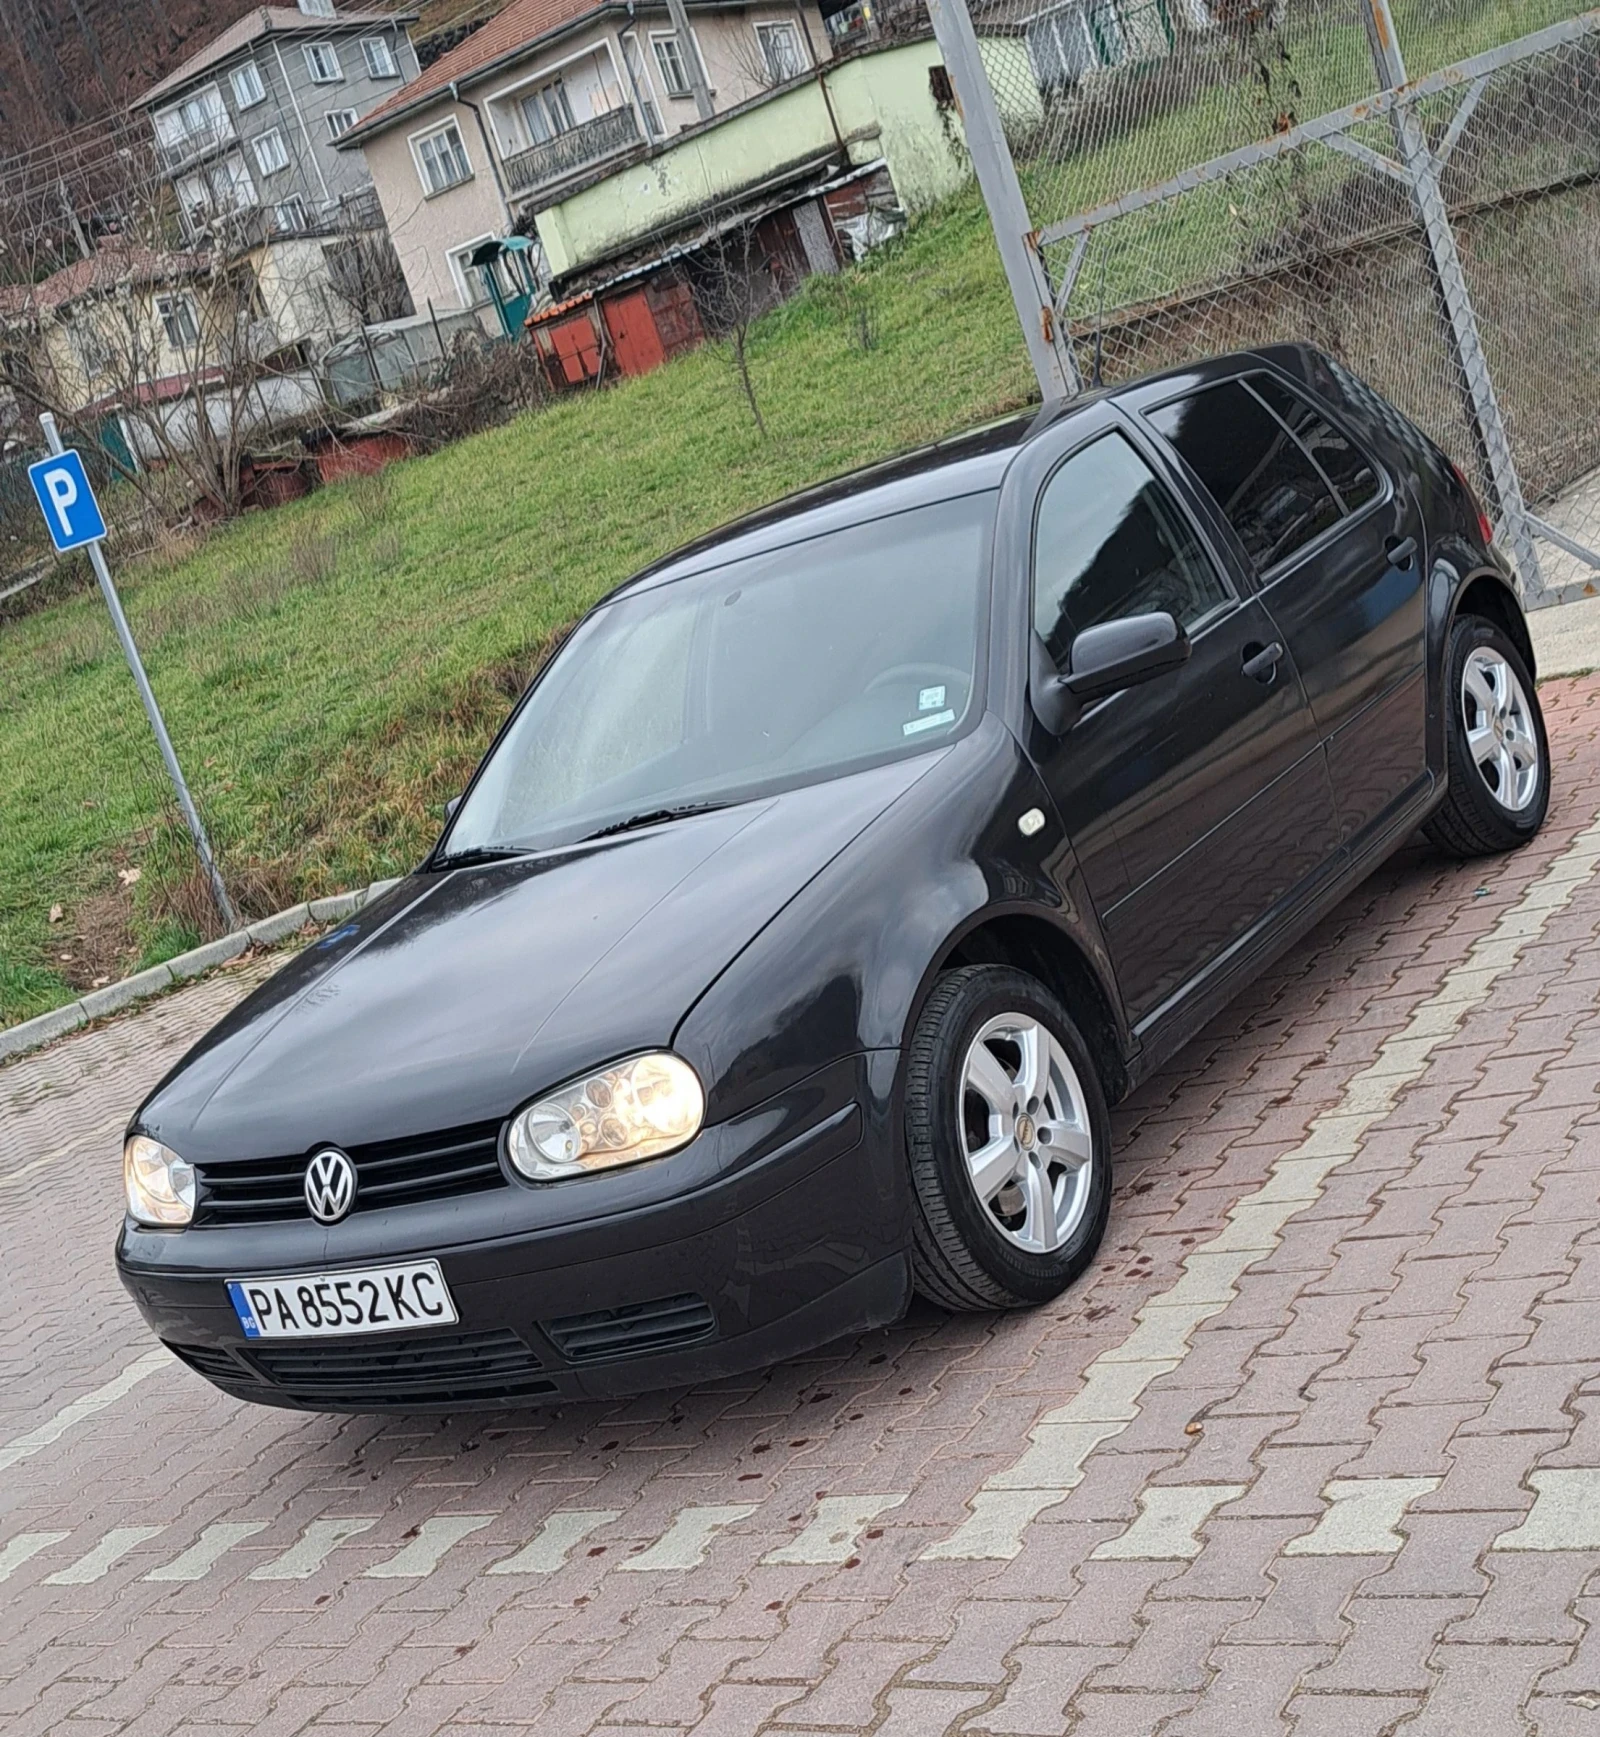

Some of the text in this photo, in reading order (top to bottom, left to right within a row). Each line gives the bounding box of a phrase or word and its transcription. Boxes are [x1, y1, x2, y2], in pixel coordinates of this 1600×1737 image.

[43, 467, 78, 537] P
[305, 1151, 353, 1221] VW
[240, 1316, 256, 1329] BG
